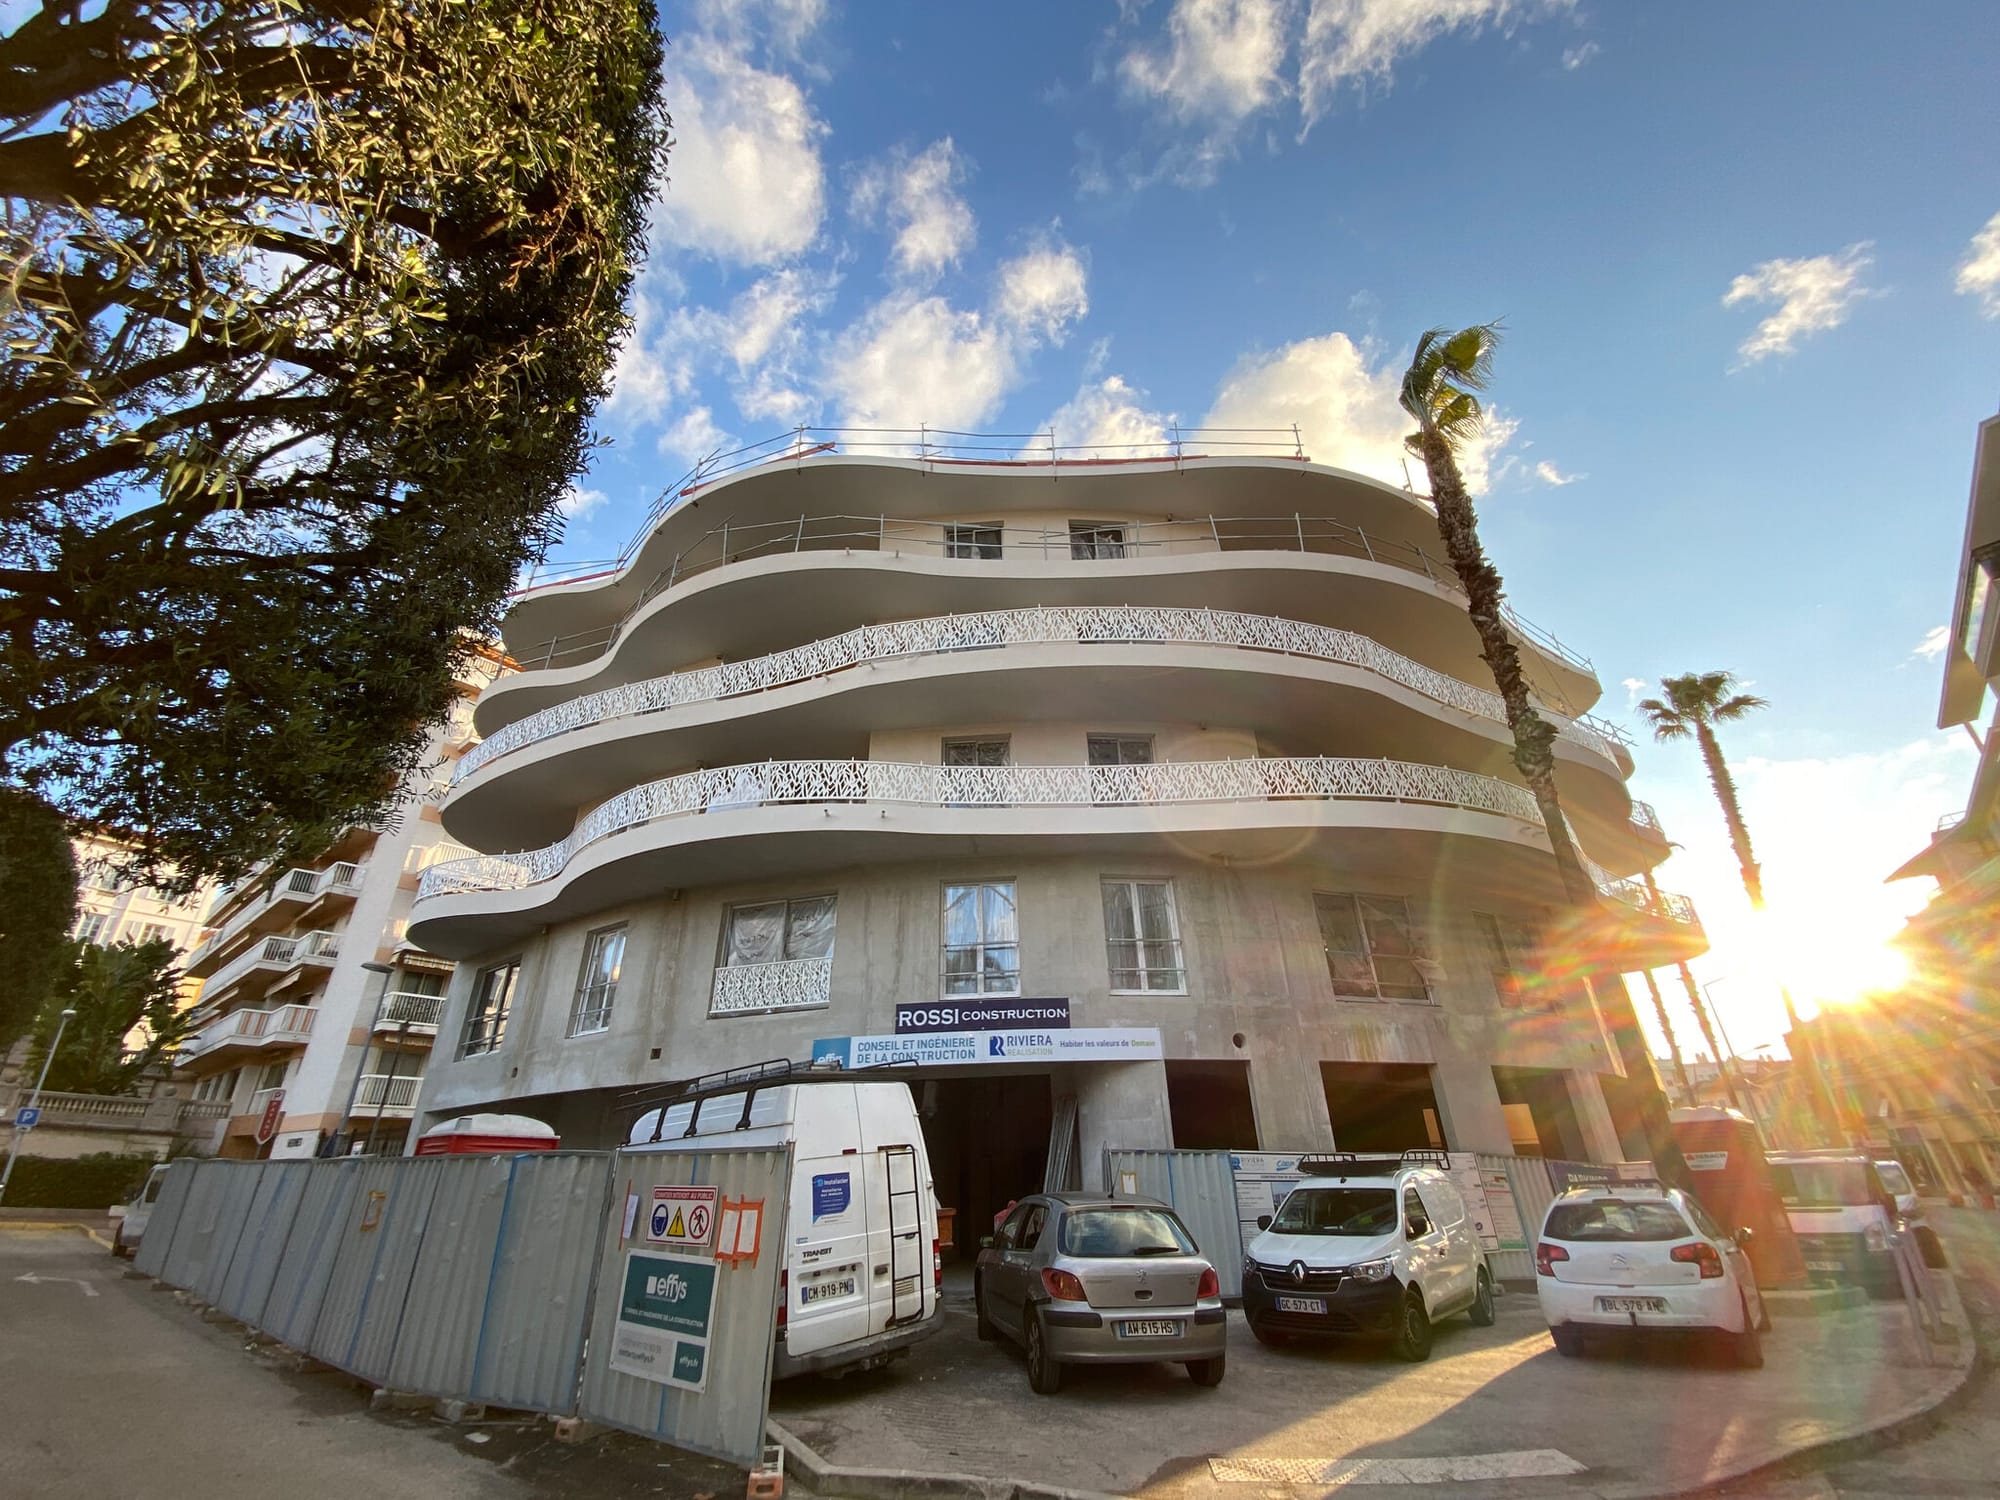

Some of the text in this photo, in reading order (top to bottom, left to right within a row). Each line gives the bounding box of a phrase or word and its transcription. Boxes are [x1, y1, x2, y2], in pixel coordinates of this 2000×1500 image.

[898, 1007, 1067, 1027] ROSSI CONSTRUCTION
[857, 1036, 976, 1052] CONSEIL ET INGÉNIERIE
[1006, 1034, 1053, 1047] RIVIERA
[1059, 1040, 1084, 1048] Habiter
[1085, 1040, 1095, 1048] les
[1096, 1039, 1120, 1048] valeurs
[1120, 1039, 1129, 1047] de
[857, 1049, 976, 1064] DE LA CONSTRUCTION
[22, 1111, 34, 1122] P
[802, 1247, 832, 1258] TRANSIT
[656, 1273, 688, 1303] effys
